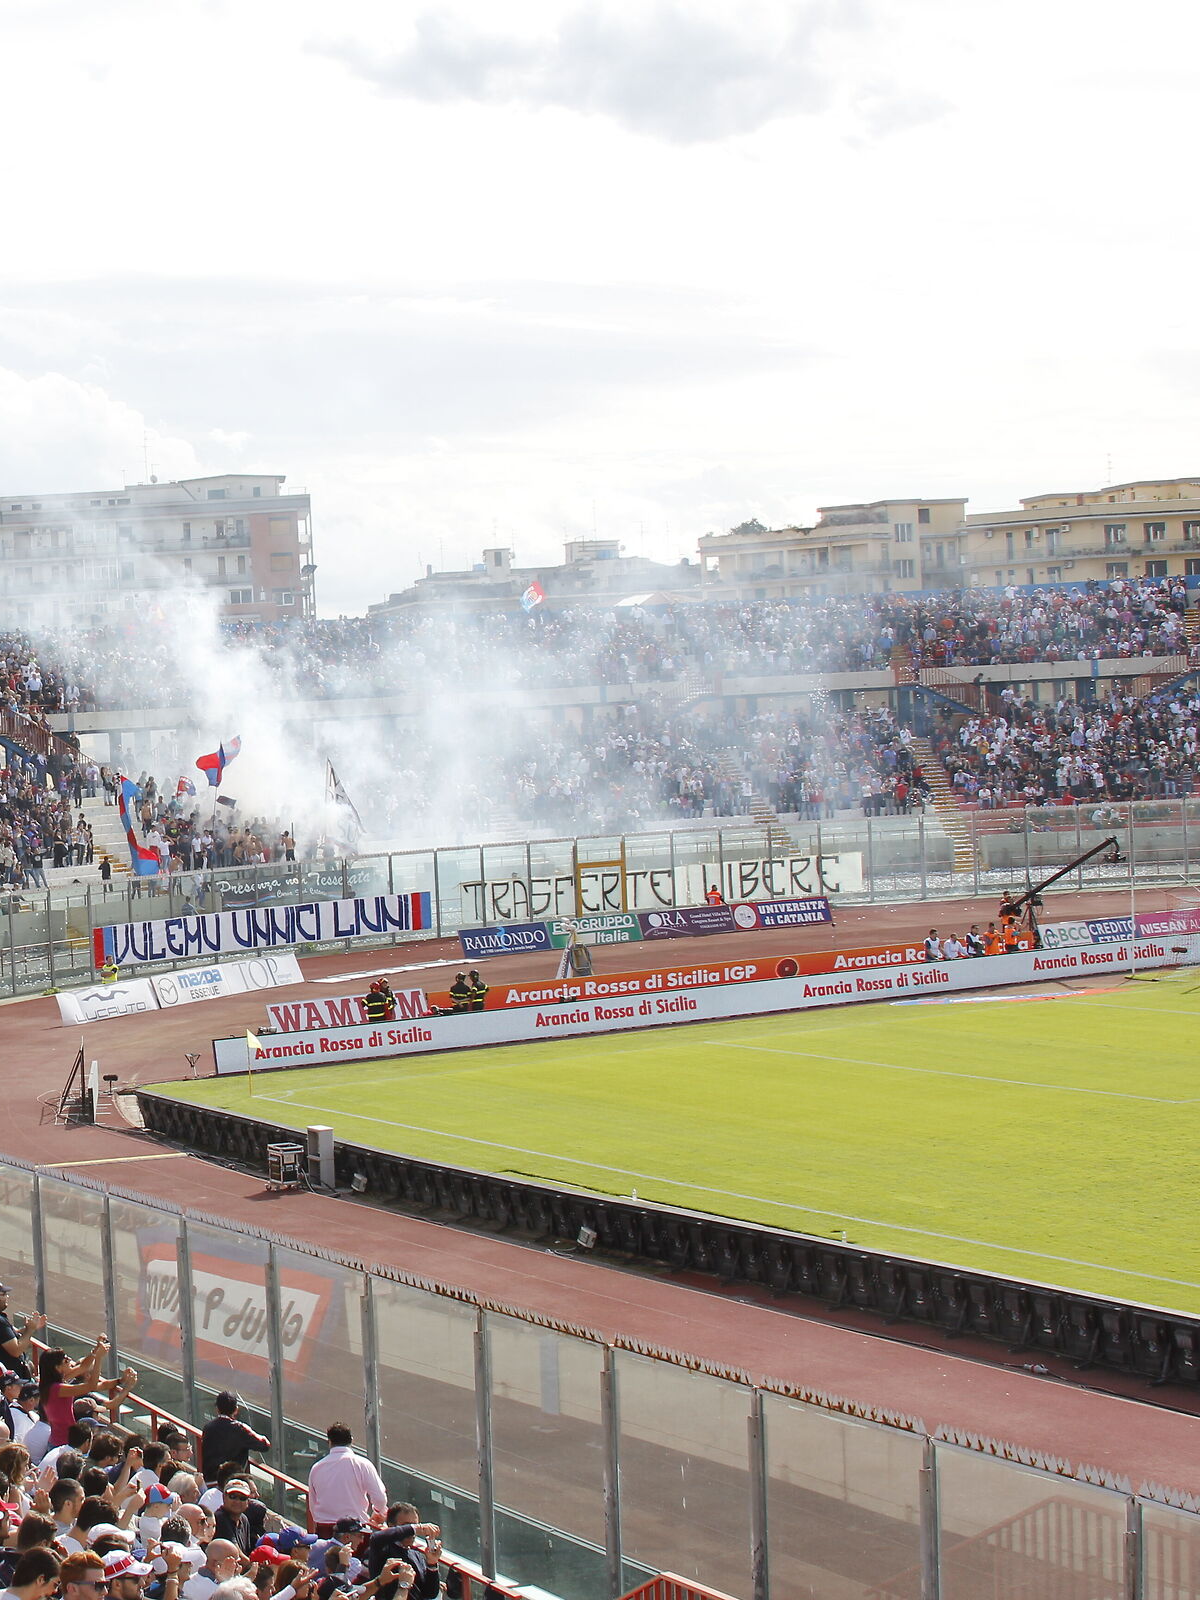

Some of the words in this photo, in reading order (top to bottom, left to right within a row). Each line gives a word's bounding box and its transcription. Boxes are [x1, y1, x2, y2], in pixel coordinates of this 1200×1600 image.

[308, 871, 371, 887] Tesseata
[463, 870, 673, 921] TRASFERTE
[232, 903, 321, 948] UNNICI
[552, 915, 632, 933] EOGRUPPO
[764, 915, 775, 925] di
[777, 911, 825, 924] CATANIA
[1088, 919, 1136, 936] CREDITO
[1140, 920, 1187, 935] NISSAN
[463, 929, 545, 951] RAIMONDO
[596, 931, 629, 944] Italia
[1058, 927, 1090, 942] BCC
[834, 949, 902, 969] Arancia
[1033, 955, 1077, 971] Arancia
[1080, 952, 1113, 965] Rossa
[1117, 946, 1128, 961] di
[1132, 943, 1165, 960] Sicilia
[232, 958, 278, 990] TOP
[505, 984, 580, 1004] Arancia
[585, 980, 640, 996] Rossa
[645, 974, 662, 989] di
[666, 969, 720, 987] Sicilia
[724, 965, 757, 981] IGP
[803, 981, 851, 998] Arancia
[856, 977, 892, 992] Rossa
[896, 973, 909, 987] di
[911, 968, 949, 986] Sicilia
[75, 1001, 146, 1023] LUCAUTO
[270, 991, 424, 1033] WAMM
[536, 1006, 590, 1027] Arancia
[594, 1005, 635, 1020] Rossa
[639, 999, 652, 1015] di
[656, 996, 697, 1013] Sicilia
[255, 1040, 315, 1060] Arancia
[319, 1036, 364, 1053] Rossa
[368, 1031, 383, 1048] di
[389, 1026, 432, 1045] Sicilia
